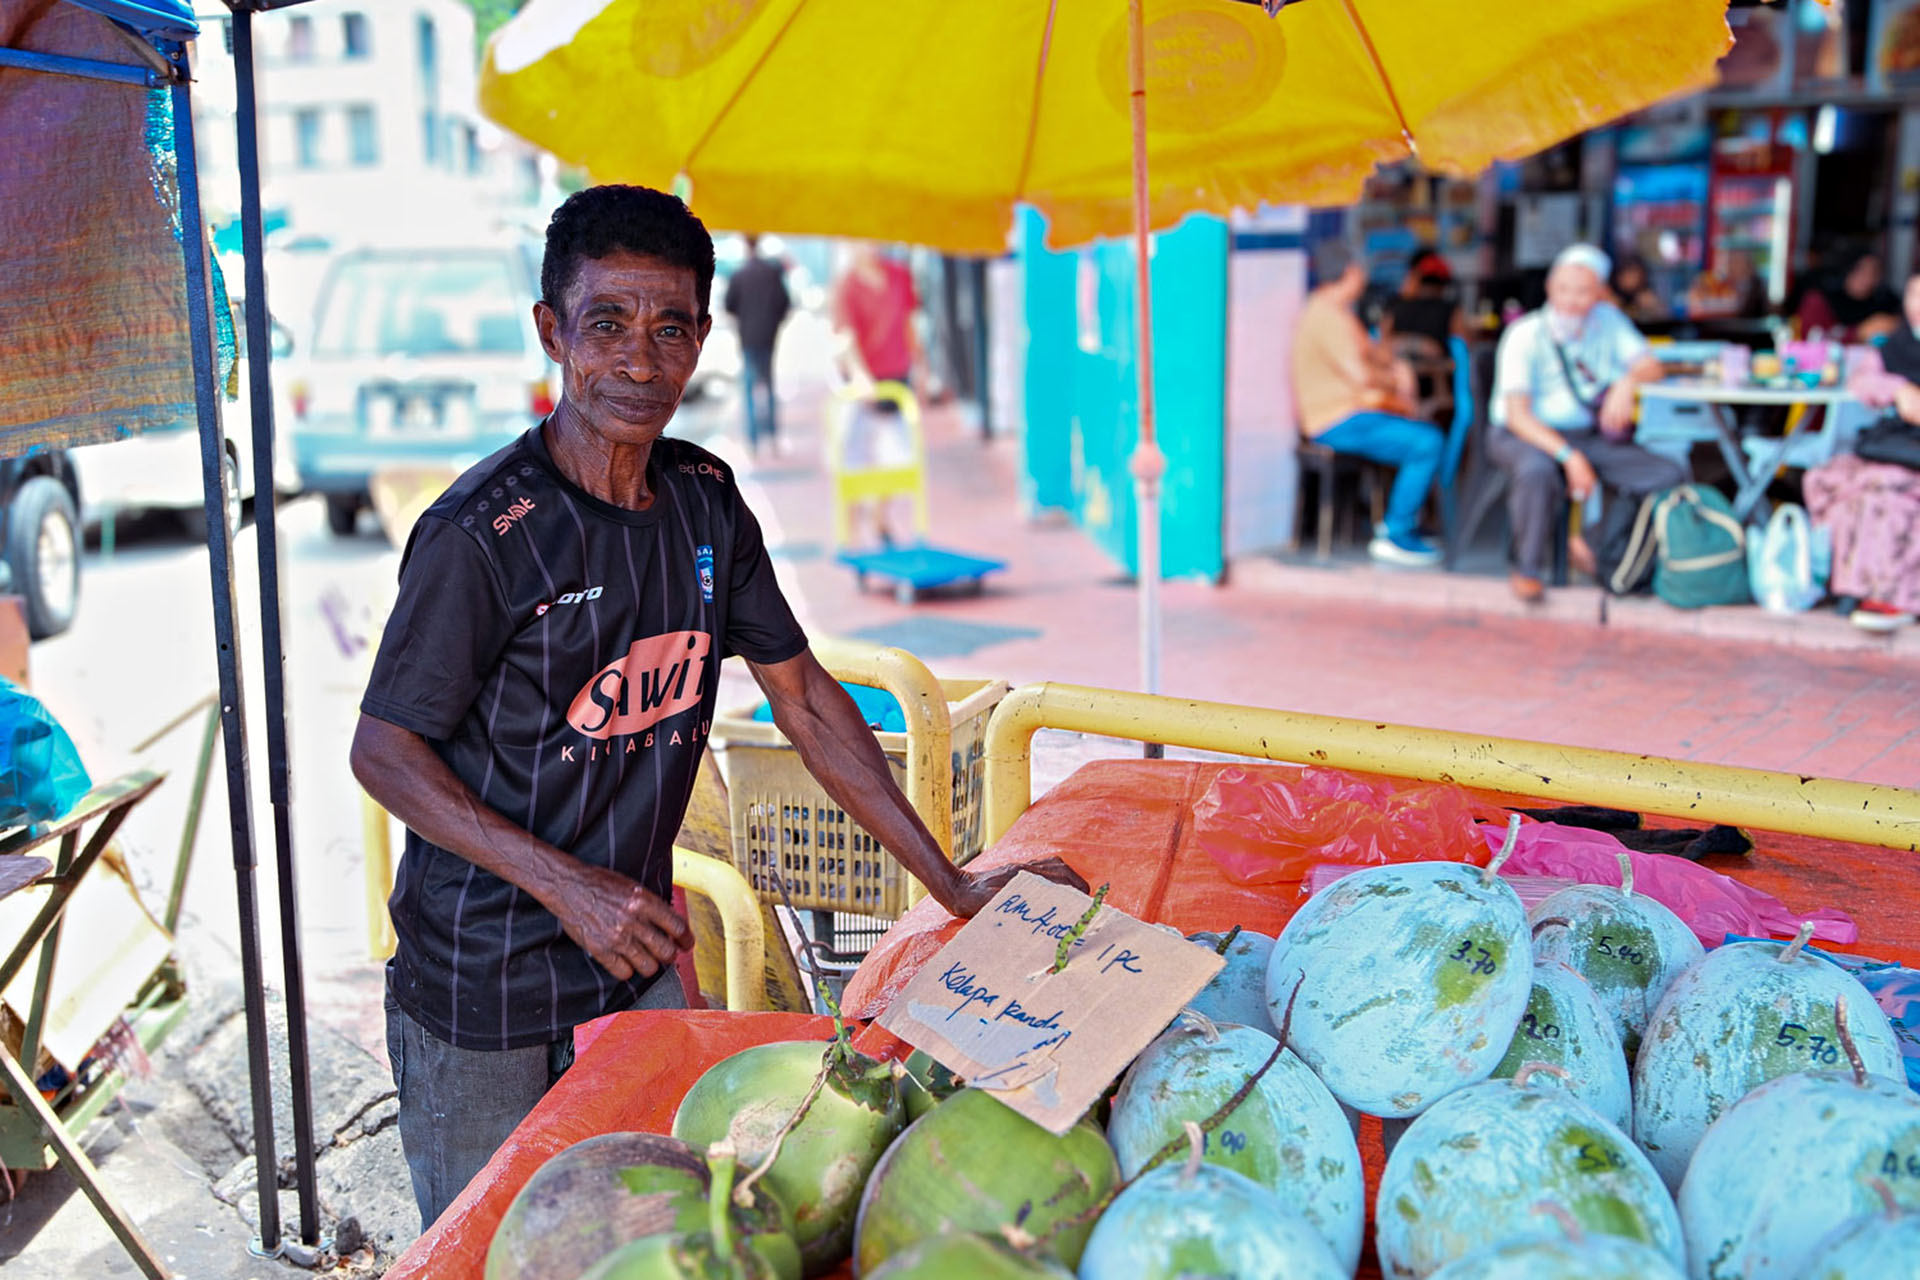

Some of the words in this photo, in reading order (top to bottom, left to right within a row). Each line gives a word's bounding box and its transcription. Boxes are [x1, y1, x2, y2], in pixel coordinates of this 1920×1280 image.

[678, 463, 696, 475] ed
[697, 463, 725, 483] ONE
[1449, 940, 1496, 976] 3.70
[1523, 1013, 1560, 1041] 20
[1775, 1022, 1838, 1064] 5.70
